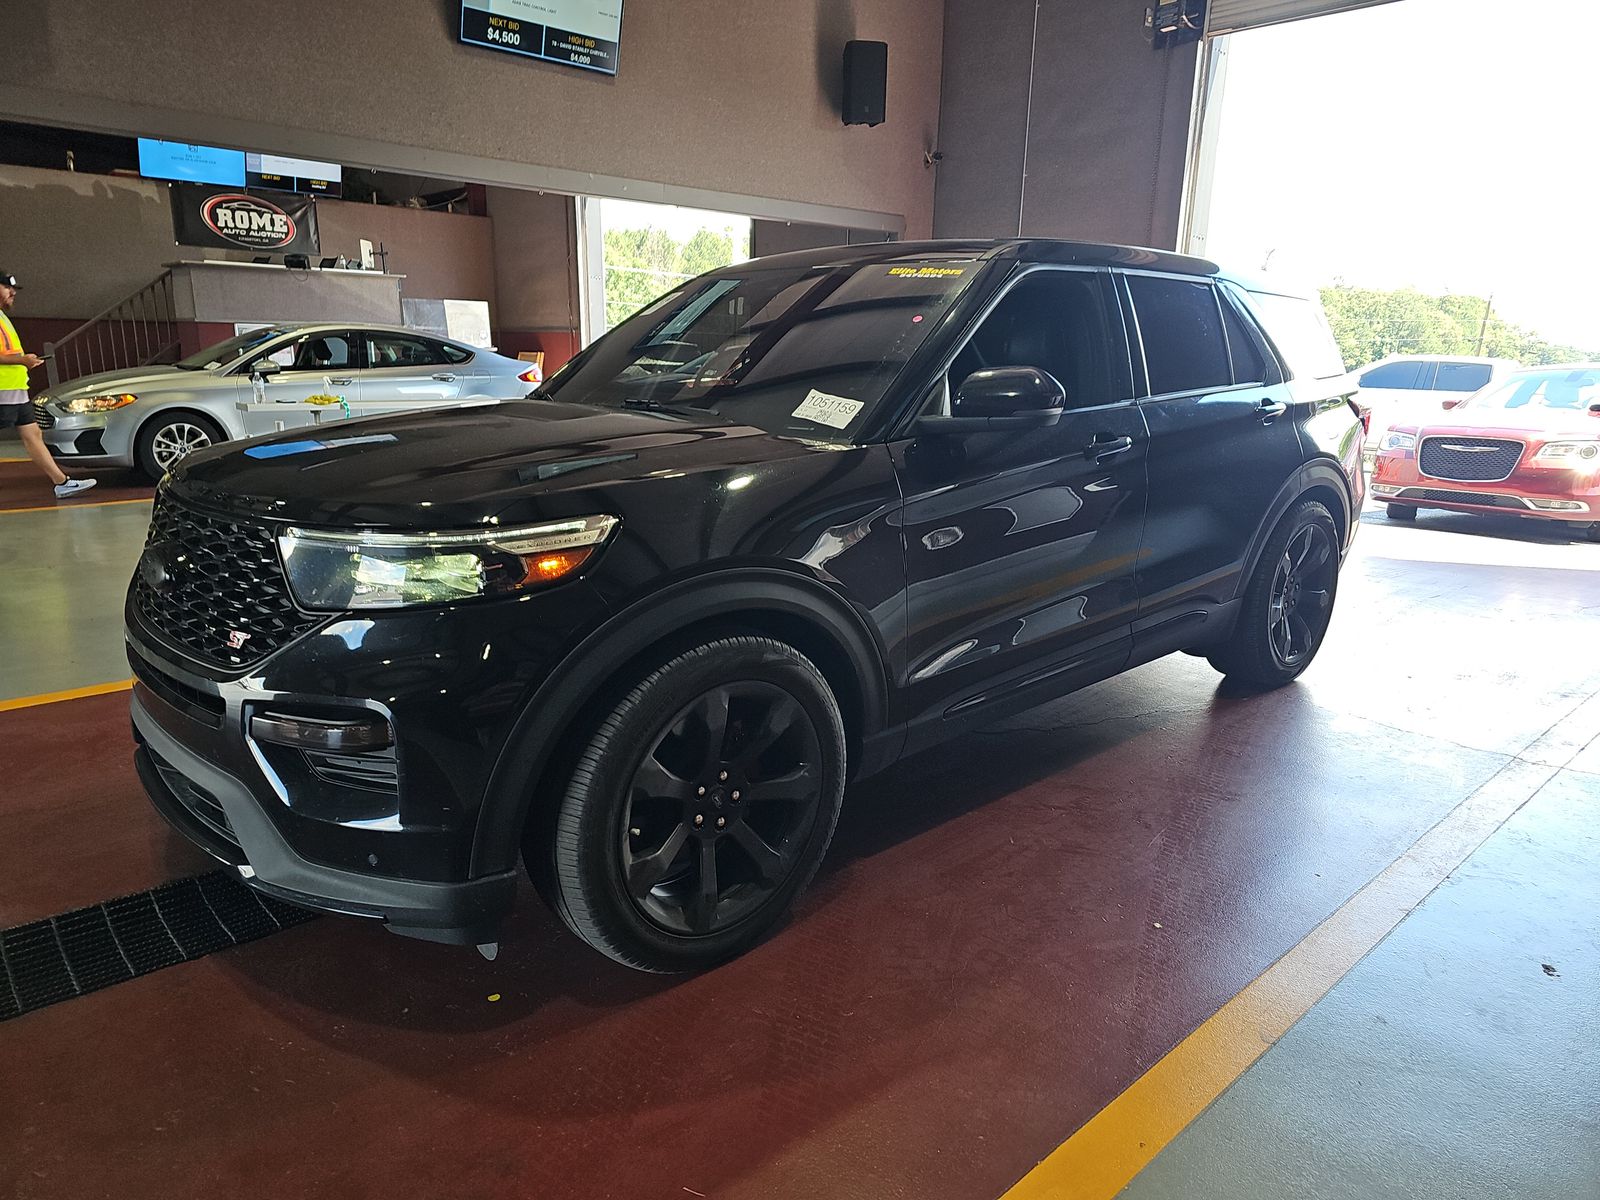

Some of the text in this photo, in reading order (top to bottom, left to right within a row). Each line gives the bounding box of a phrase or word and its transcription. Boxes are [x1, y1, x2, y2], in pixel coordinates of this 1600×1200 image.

[489, 16, 520, 31] NEXT BID
[487, 26, 520, 45] $4,500
[568, 35, 596, 48] HIGH BID
[560, 42, 572, 50] DAVID
[572, 45, 590, 54] STANLEY
[570, 52, 591, 65] $4,000
[216, 208, 288, 232] ROME
[249, 230, 286, 239] AUCTION
[888, 267, 964, 275] Elite Motors
[807, 394, 857, 415] 1051159
[516, 534, 591, 549] EXPLORER
